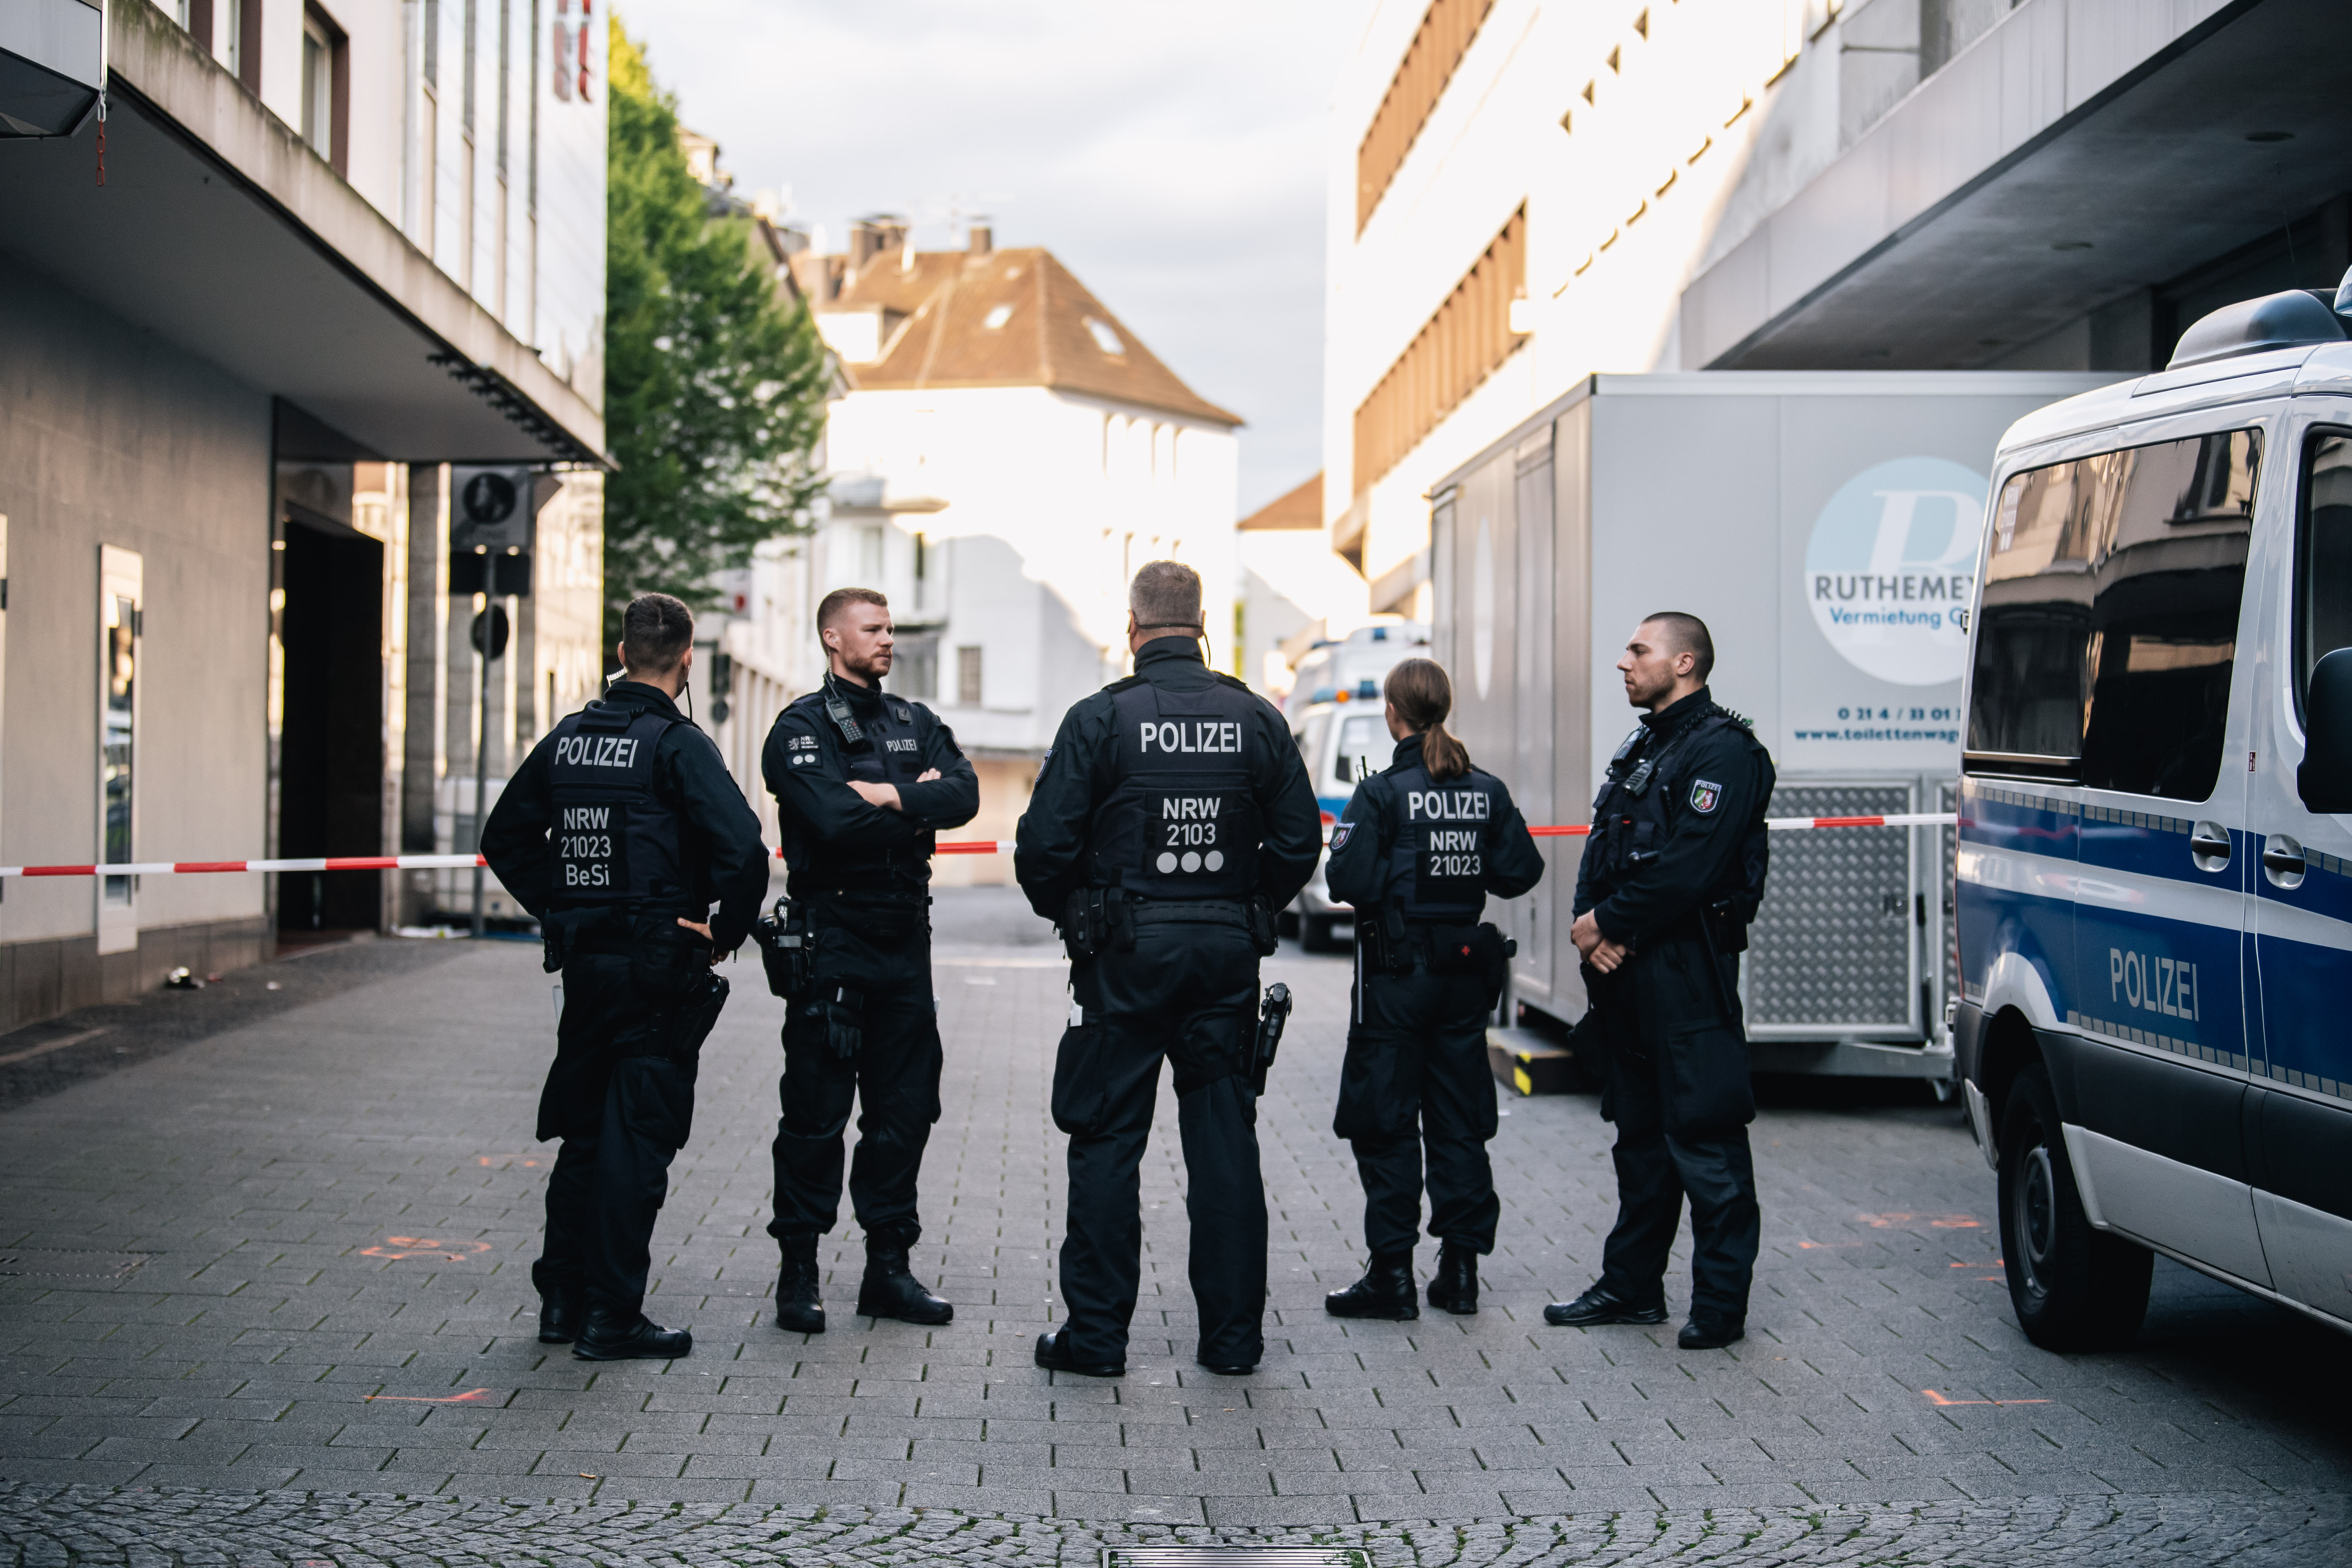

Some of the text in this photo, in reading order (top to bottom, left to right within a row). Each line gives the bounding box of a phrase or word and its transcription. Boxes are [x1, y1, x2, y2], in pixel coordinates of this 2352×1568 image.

[1816, 575, 1974, 601] RUTHEME
[1829, 607, 1942, 629] Vermietung
[886, 739, 917, 752] POLIZEI
[1141, 722, 1241, 753] POLIZEI
[555, 736, 638, 768] POLIZEI
[1696, 781, 1721, 792] POLIZEI
[1163, 798, 1220, 819] NRW
[1408, 791, 1490, 820] POLIZEI
[564, 808, 609, 830] NRW
[1167, 823, 1216, 846] 2103
[1430, 831, 1477, 851] NRW
[561, 836, 611, 858] 21023
[566, 864, 610, 886] BeSi
[1430, 855, 1481, 876] 21023
[2110, 948, 2199, 1021] POLIZEI
